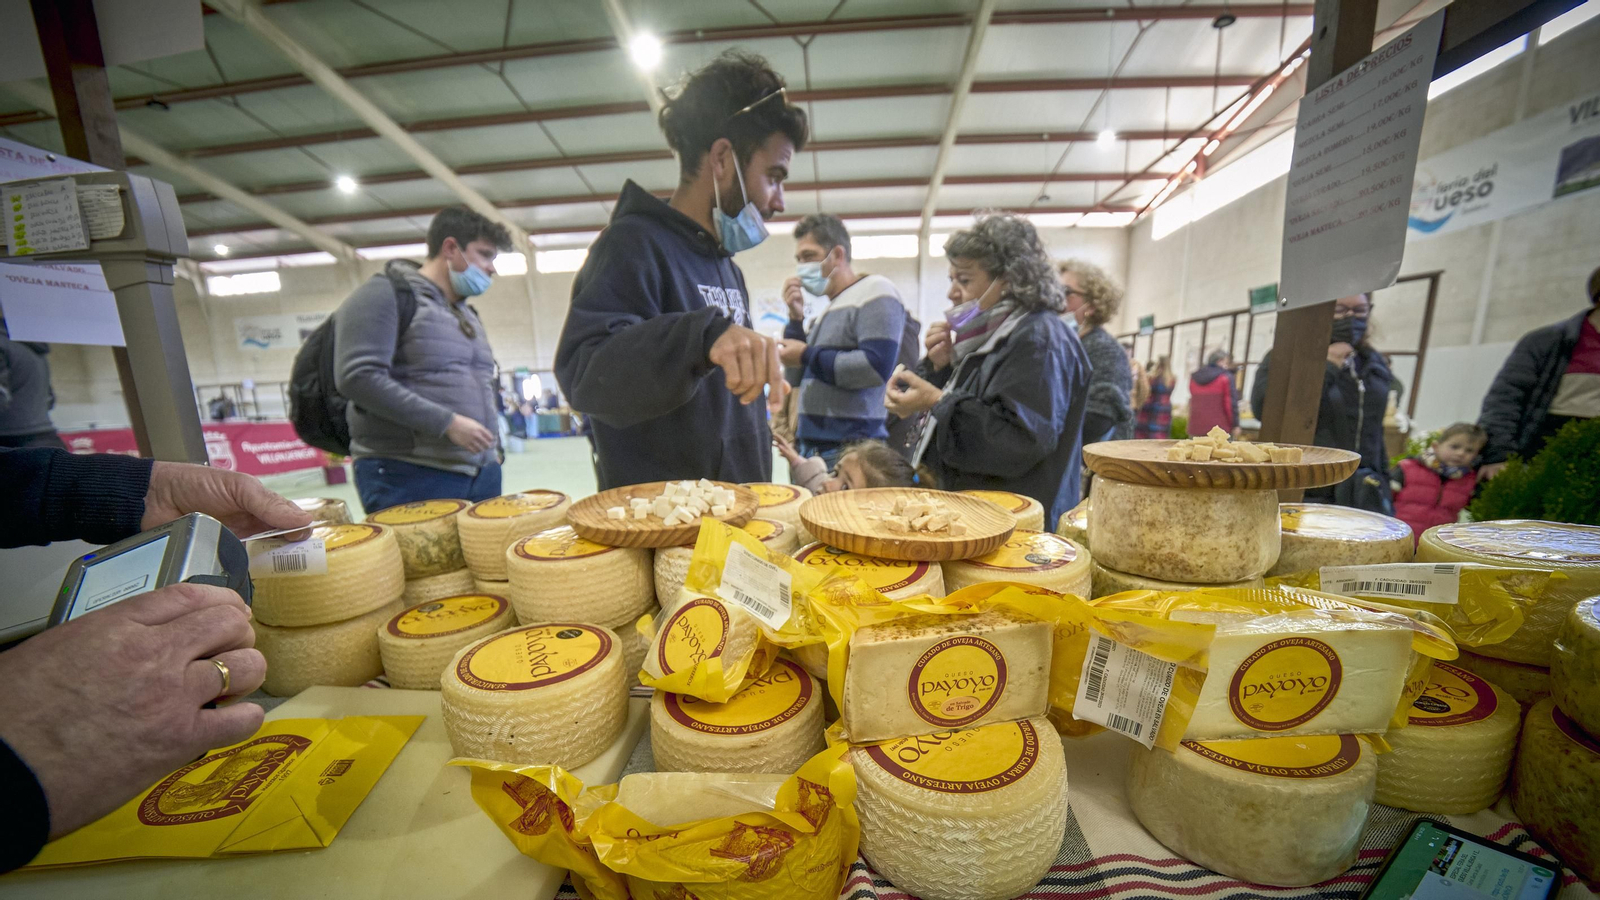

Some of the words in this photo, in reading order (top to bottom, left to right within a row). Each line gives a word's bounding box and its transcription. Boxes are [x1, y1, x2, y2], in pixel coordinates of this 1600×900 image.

[1315, 79, 1343, 102] LISTA
[1362, 34, 1412, 72] PRECIOS
[45, 280, 90, 290] MANTECA
[917, 645, 941, 668] CURADO
[941, 641, 952, 649] DE
[952, 638, 973, 646] OVEJA
[974, 639, 1002, 661] ARTESANO
[1240, 649, 1266, 671] CURADO
[1267, 642, 1278, 650] DE
[1280, 639, 1304, 647] OVEJA
[1304, 640, 1336, 661] ARTESANO
[1269, 671, 1302, 680] QUESO
[784, 697, 807, 717] CURADO
[691, 721, 738, 734] ARTESANO
[744, 722, 771, 733] OVEJA
[773, 716, 784, 725] DE
[945, 727, 981, 752] QUESO
[1027, 749, 1034, 757] DE
[1187, 741, 1240, 767] ARTESAN
[1012, 757, 1032, 777] CABRA
[1248, 764, 1288, 776] OVEJA
[1311, 757, 1348, 775] CURADO
[902, 771, 963, 791] ARTESANO
[966, 778, 1001, 793] OVEJA
[1001, 775, 1010, 783] Y
[167, 811, 215, 824] QUESOS
